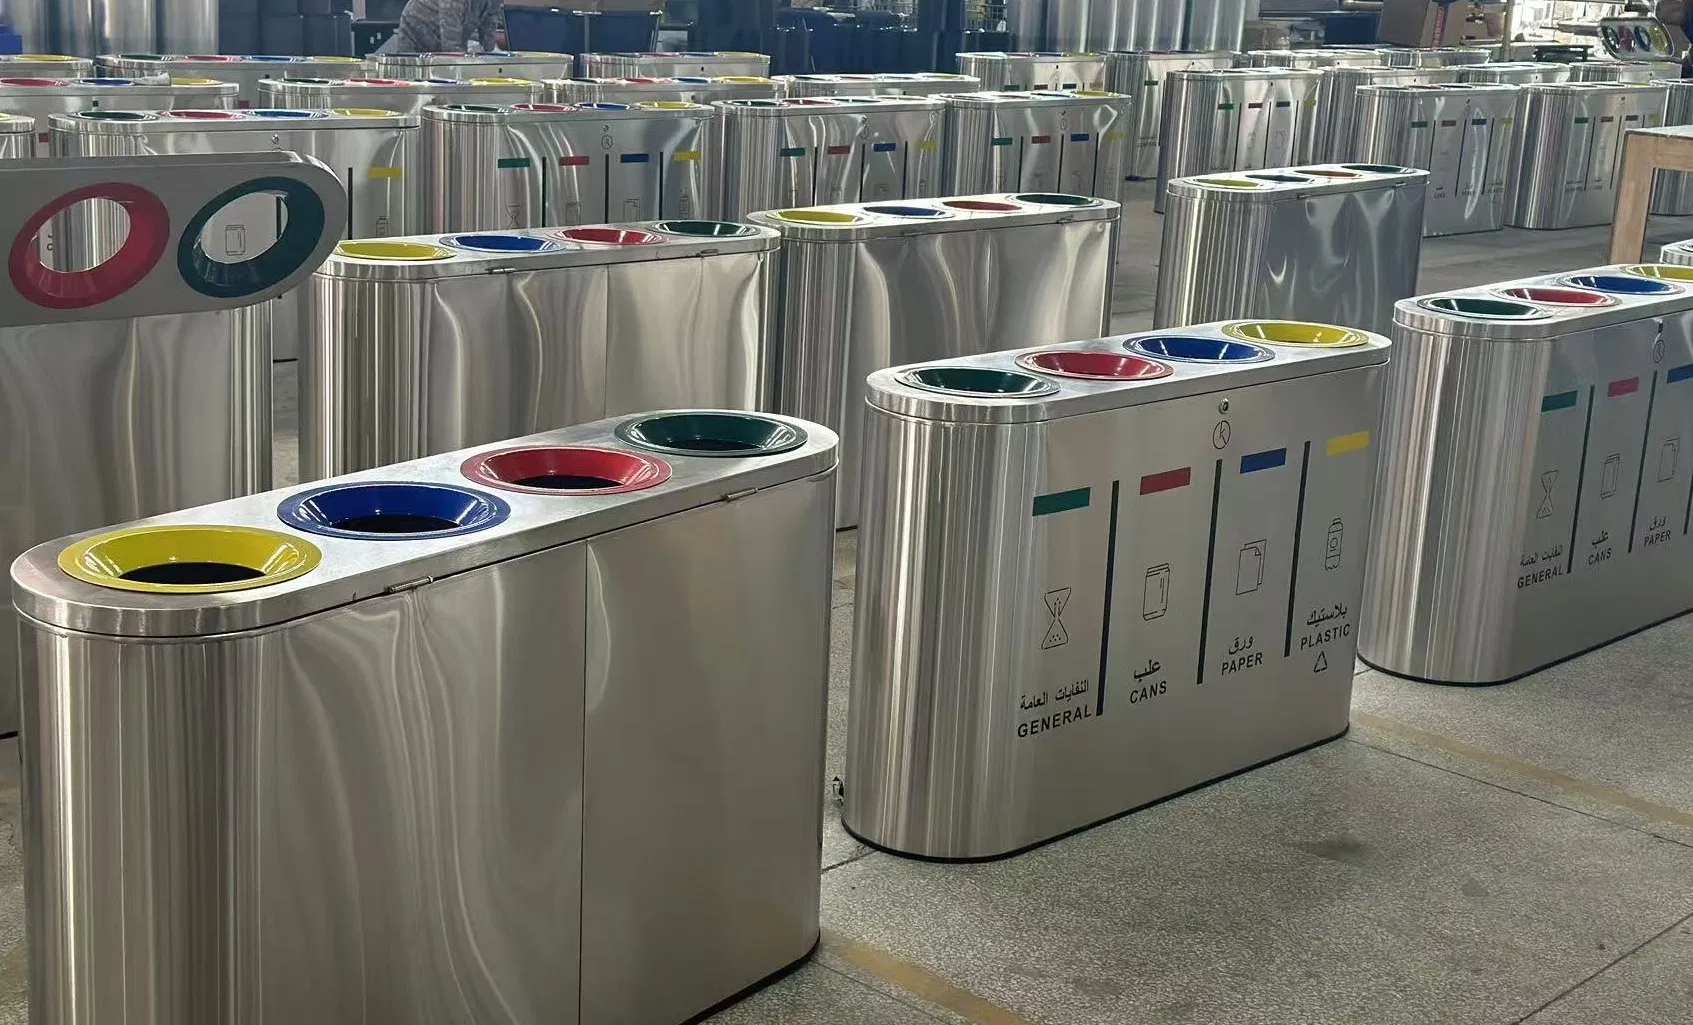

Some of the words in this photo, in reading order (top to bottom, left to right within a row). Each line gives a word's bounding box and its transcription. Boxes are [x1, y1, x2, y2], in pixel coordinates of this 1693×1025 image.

[1643, 529, 1672, 547] PAPER
[1588, 547, 1612, 567] CANS
[1517, 564, 1563, 589] GENERAL
[1306, 603, 1348, 628] بلاستيك
[1228, 636, 1254, 655] ورق
[1300, 623, 1351, 651] PLASTIC
[1133, 659, 1161, 683] علب
[1221, 652, 1263, 676] PAPER
[1020, 691, 1048, 710] العامة
[1055, 679, 1089, 702] النفايات
[1129, 680, 1167, 704] CANS
[1017, 703, 1092, 738] GENERAL
